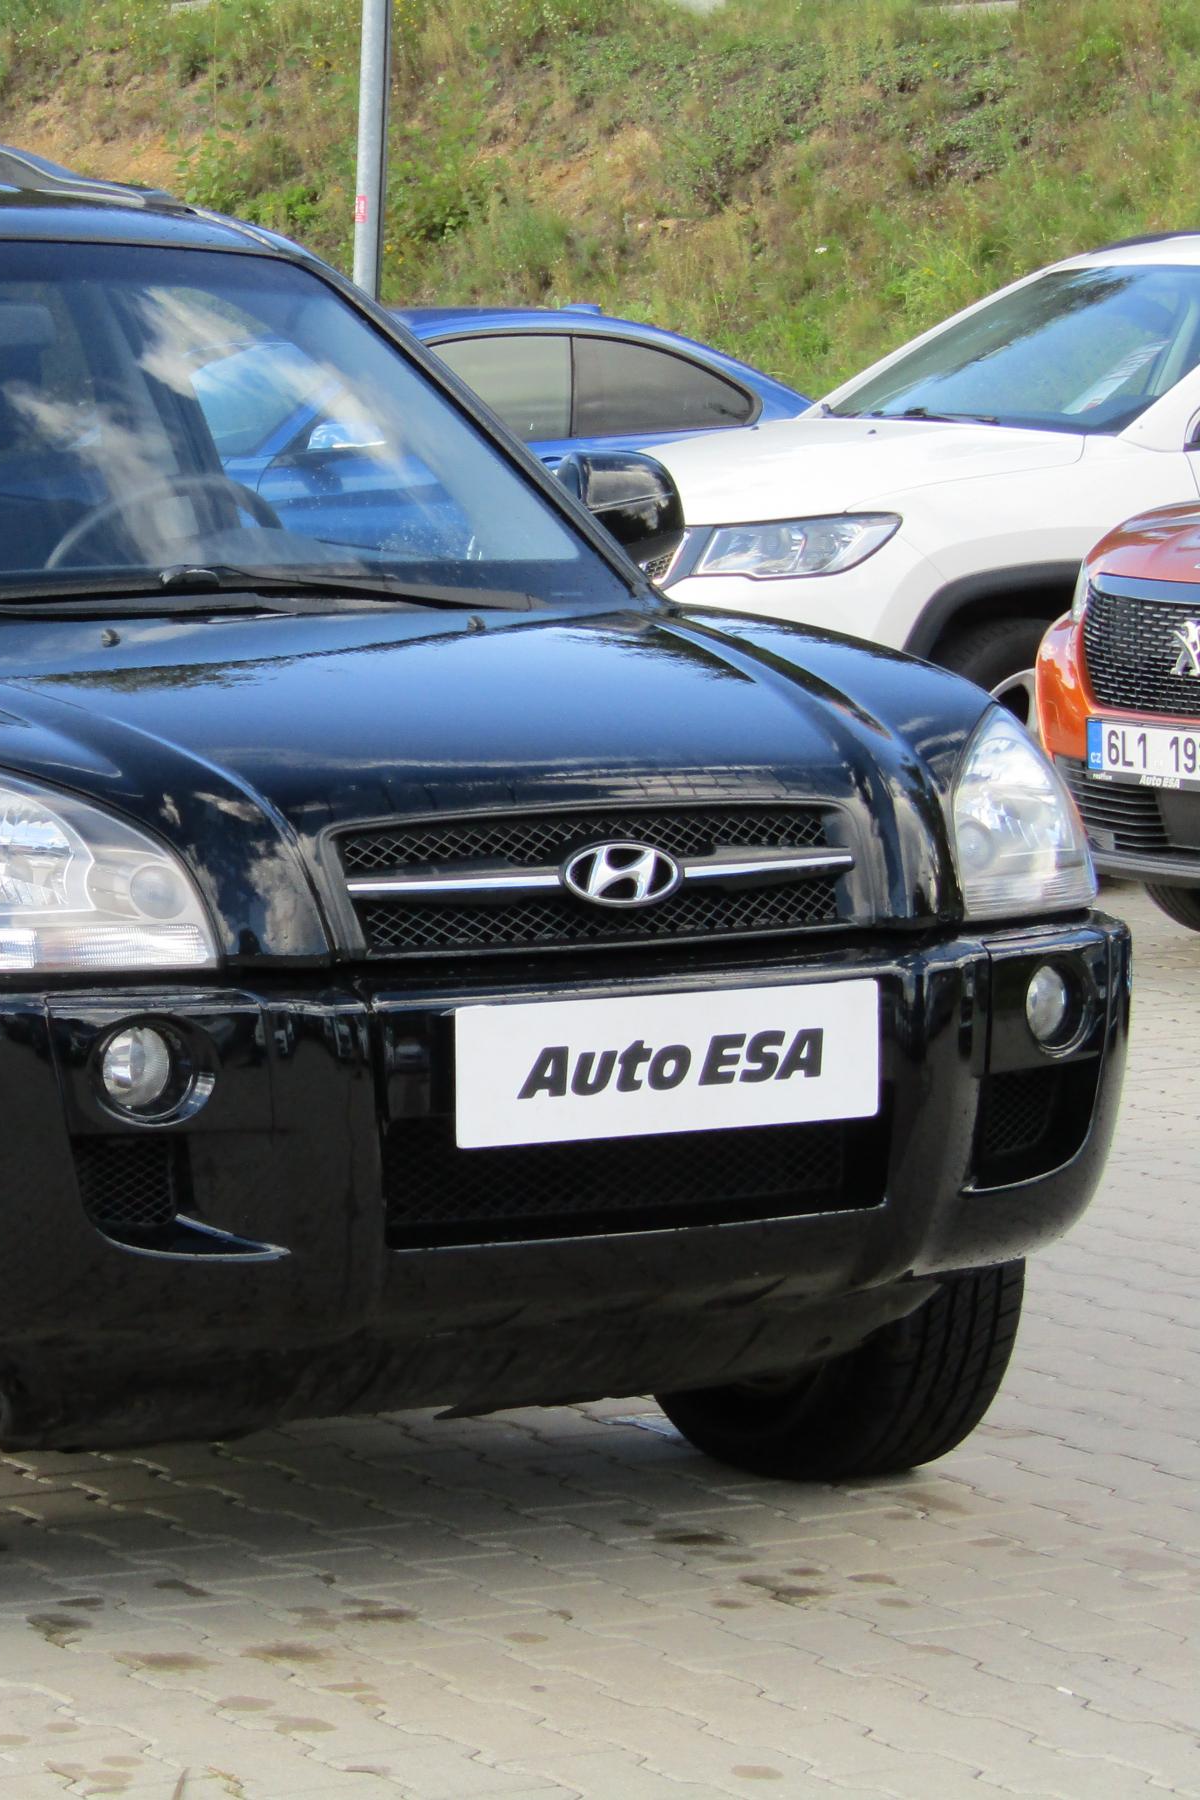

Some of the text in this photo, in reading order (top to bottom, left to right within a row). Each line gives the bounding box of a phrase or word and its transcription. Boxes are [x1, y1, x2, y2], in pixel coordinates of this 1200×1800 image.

[1090, 752, 1101, 764] CZ
[1107, 729, 1200, 773] 6L1 19
[1139, 774, 1180, 789] Auto ESA
[517, 1028, 824, 1100] Auto ESA
